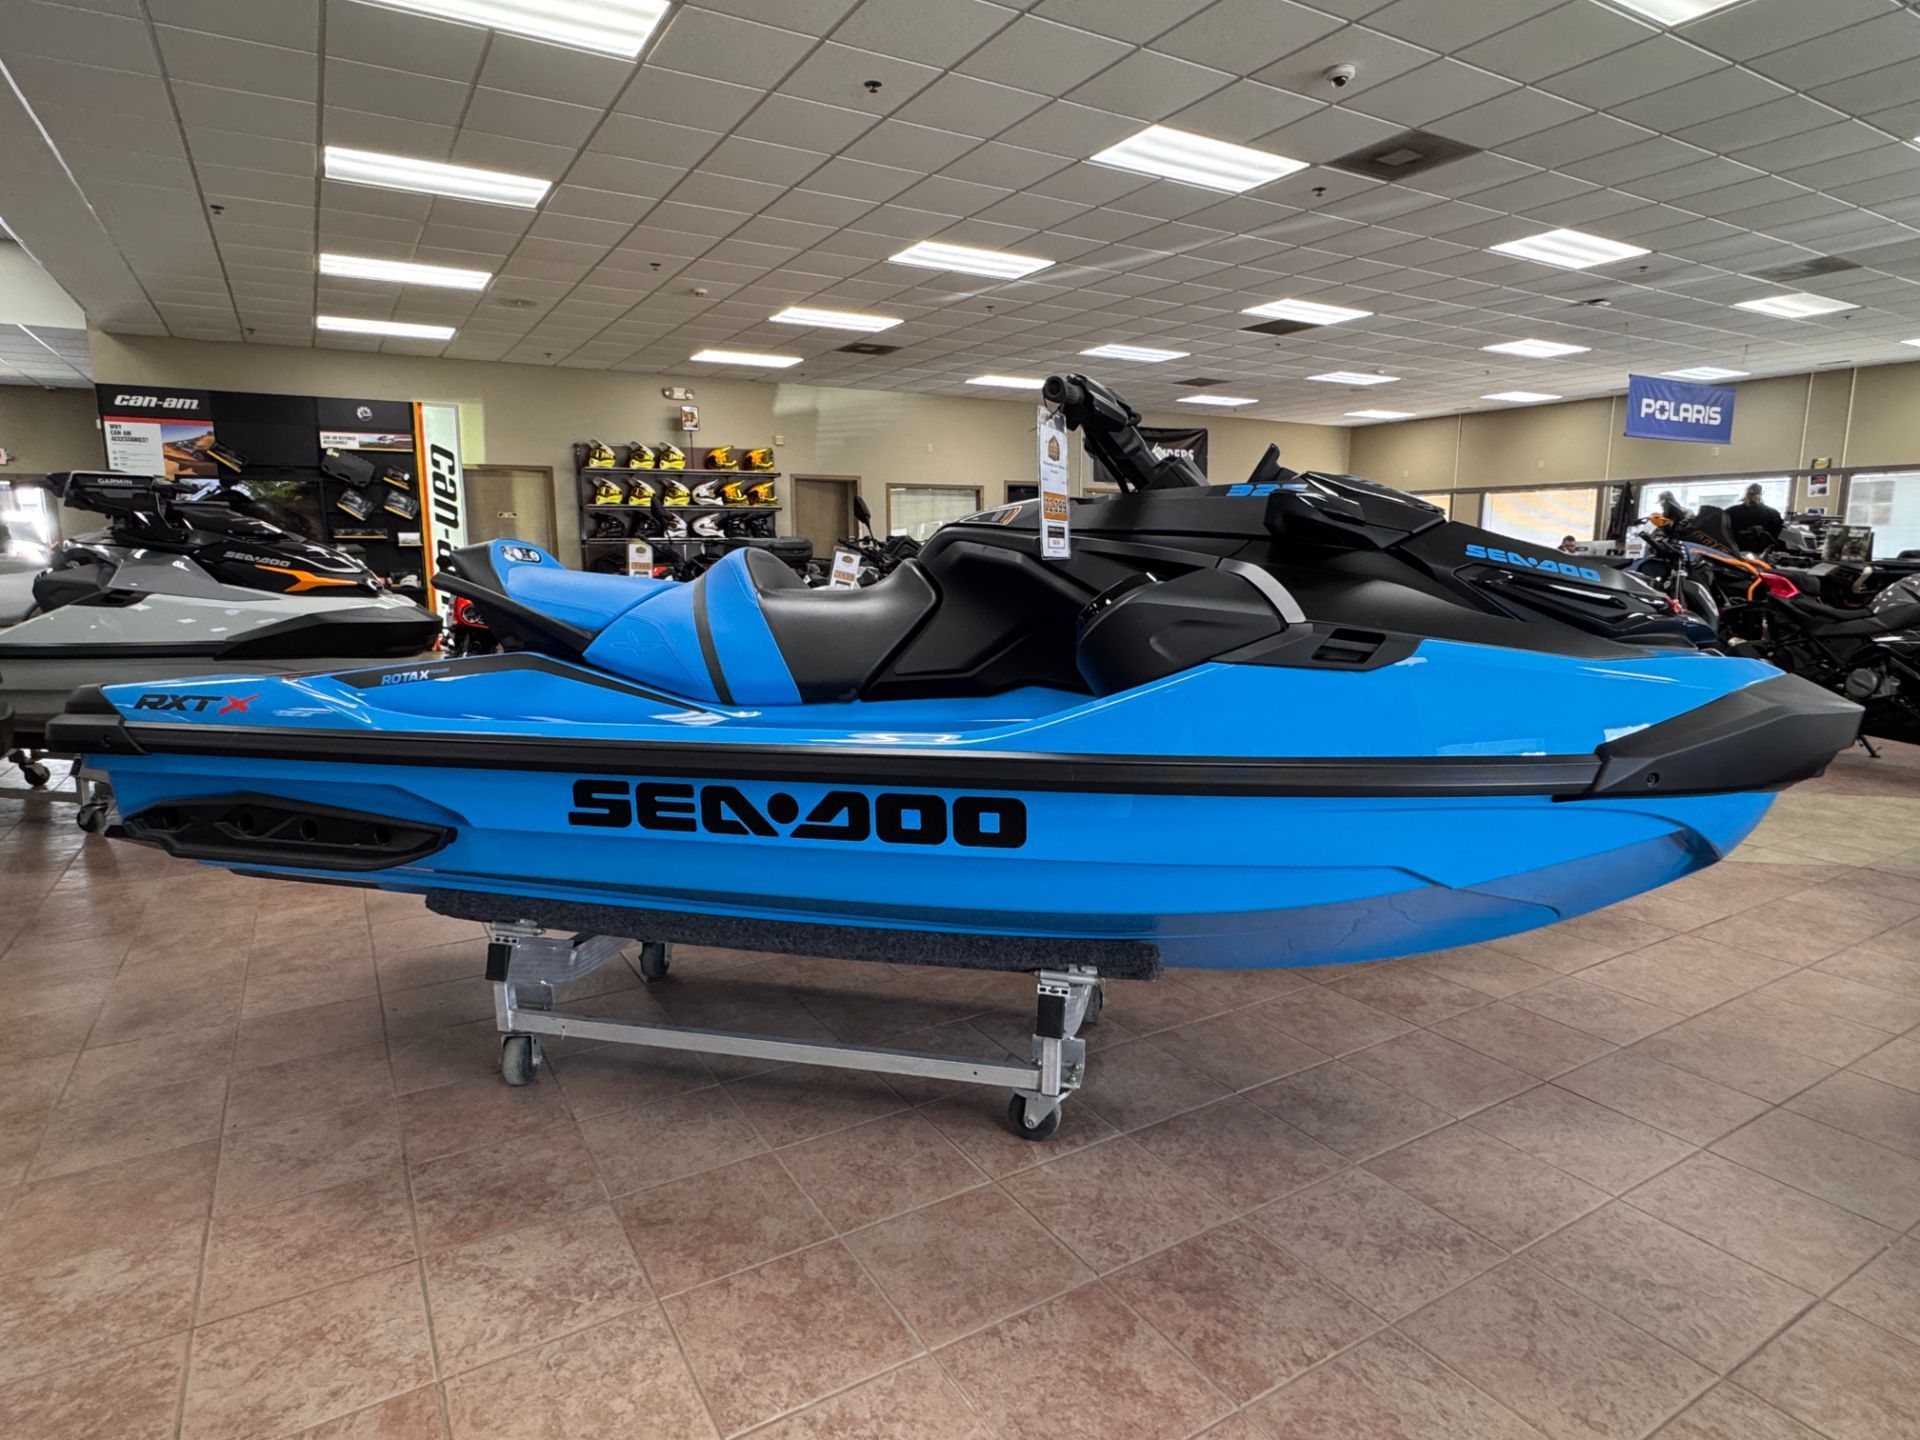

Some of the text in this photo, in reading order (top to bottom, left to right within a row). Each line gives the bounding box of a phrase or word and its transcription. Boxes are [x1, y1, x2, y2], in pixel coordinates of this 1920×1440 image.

[114, 394, 199, 410] can-am
[1640, 398, 1722, 426] POLARIS
[381, 669, 430, 686] ROTAX
